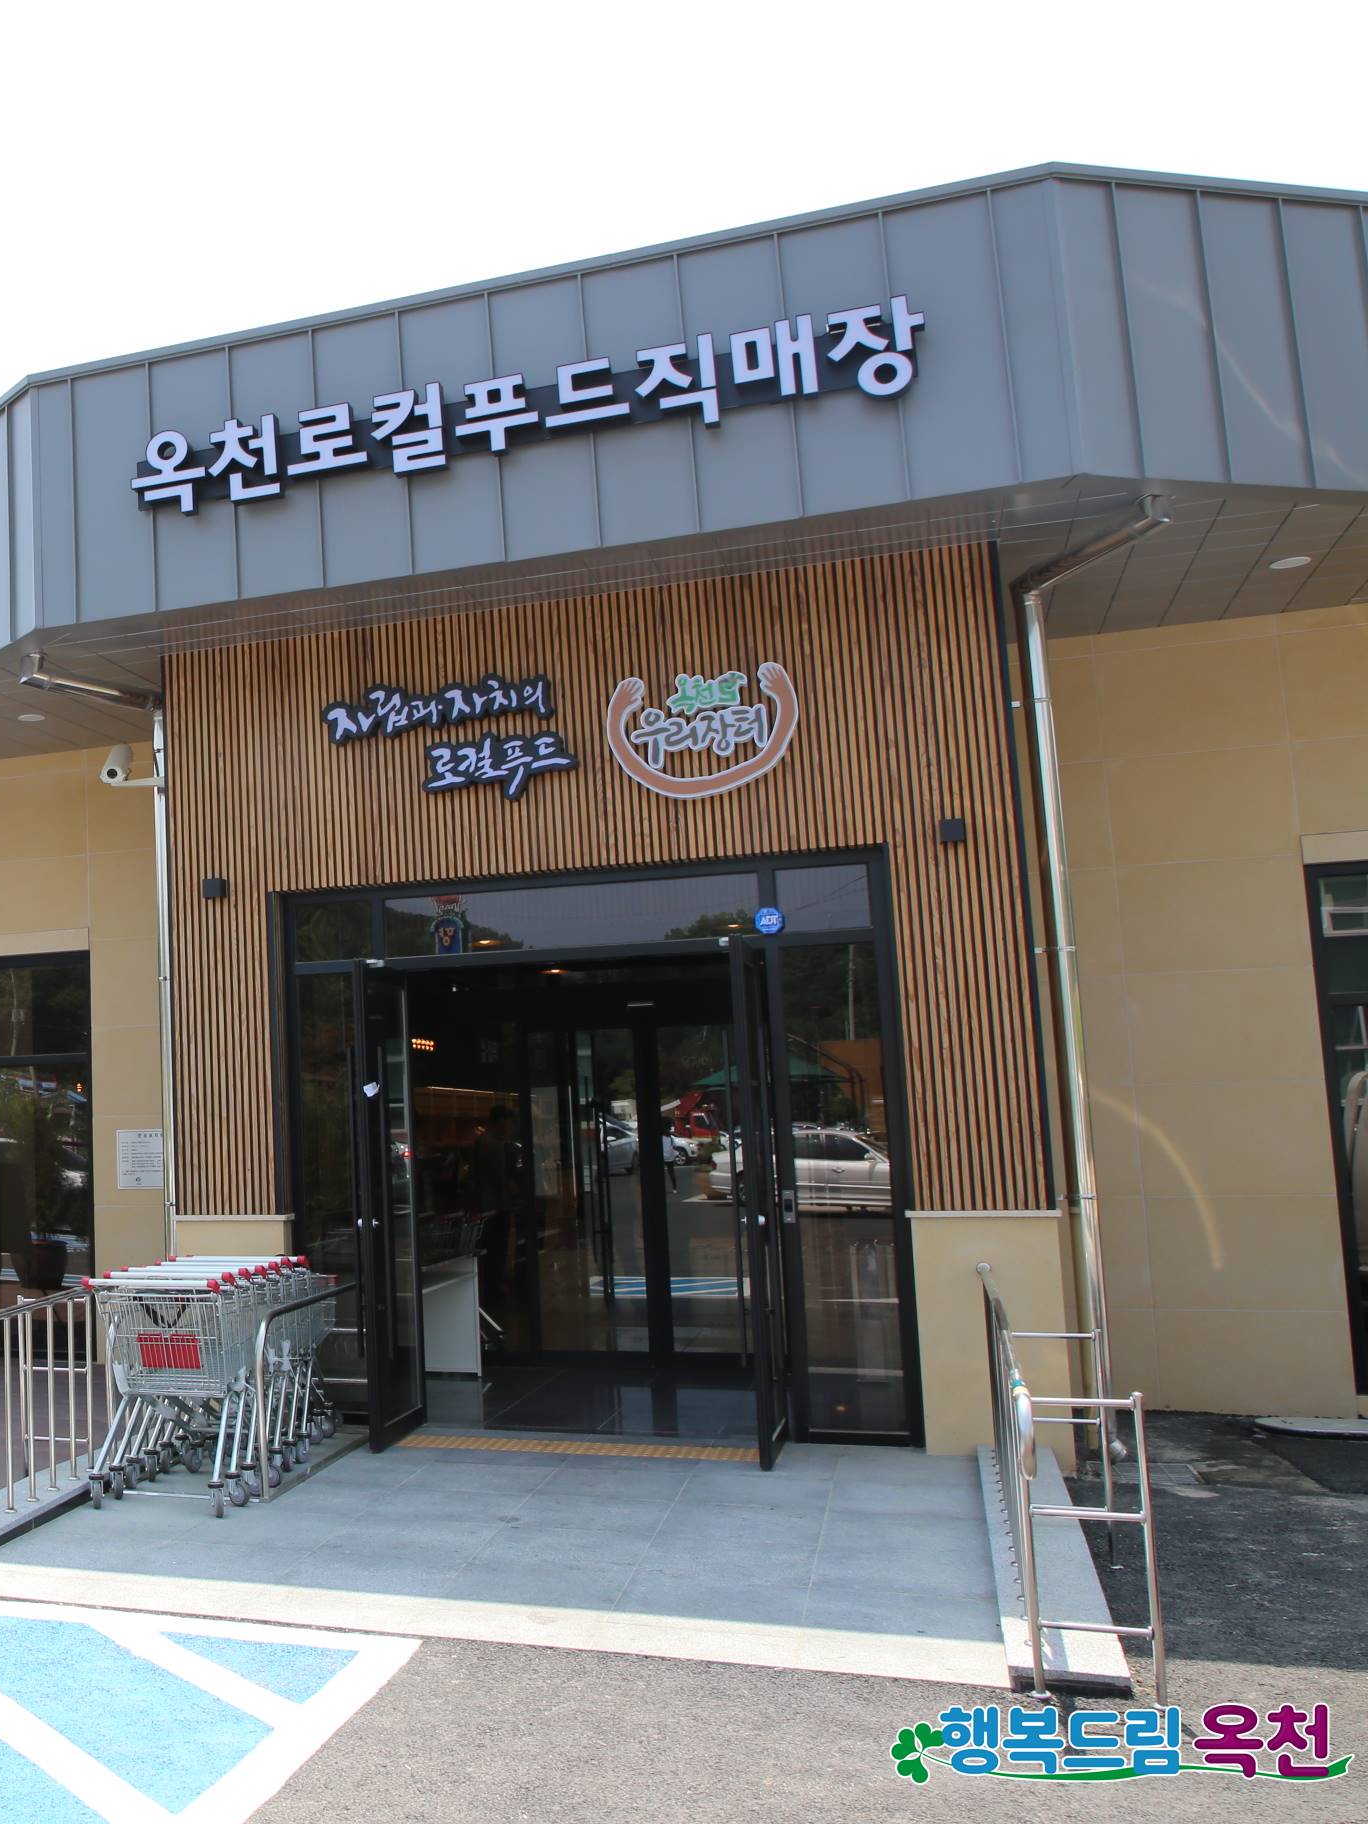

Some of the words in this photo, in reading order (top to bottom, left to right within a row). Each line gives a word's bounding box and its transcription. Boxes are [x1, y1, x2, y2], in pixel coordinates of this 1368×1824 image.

[131, 294, 924, 514] 옥천로컬푸드직매장
[444, 679, 551, 722] 자치의
[633, 705, 766, 767] 우리장터
[427, 737, 573, 796] 로컬푸드
[759, 914, 779, 926] ADT
